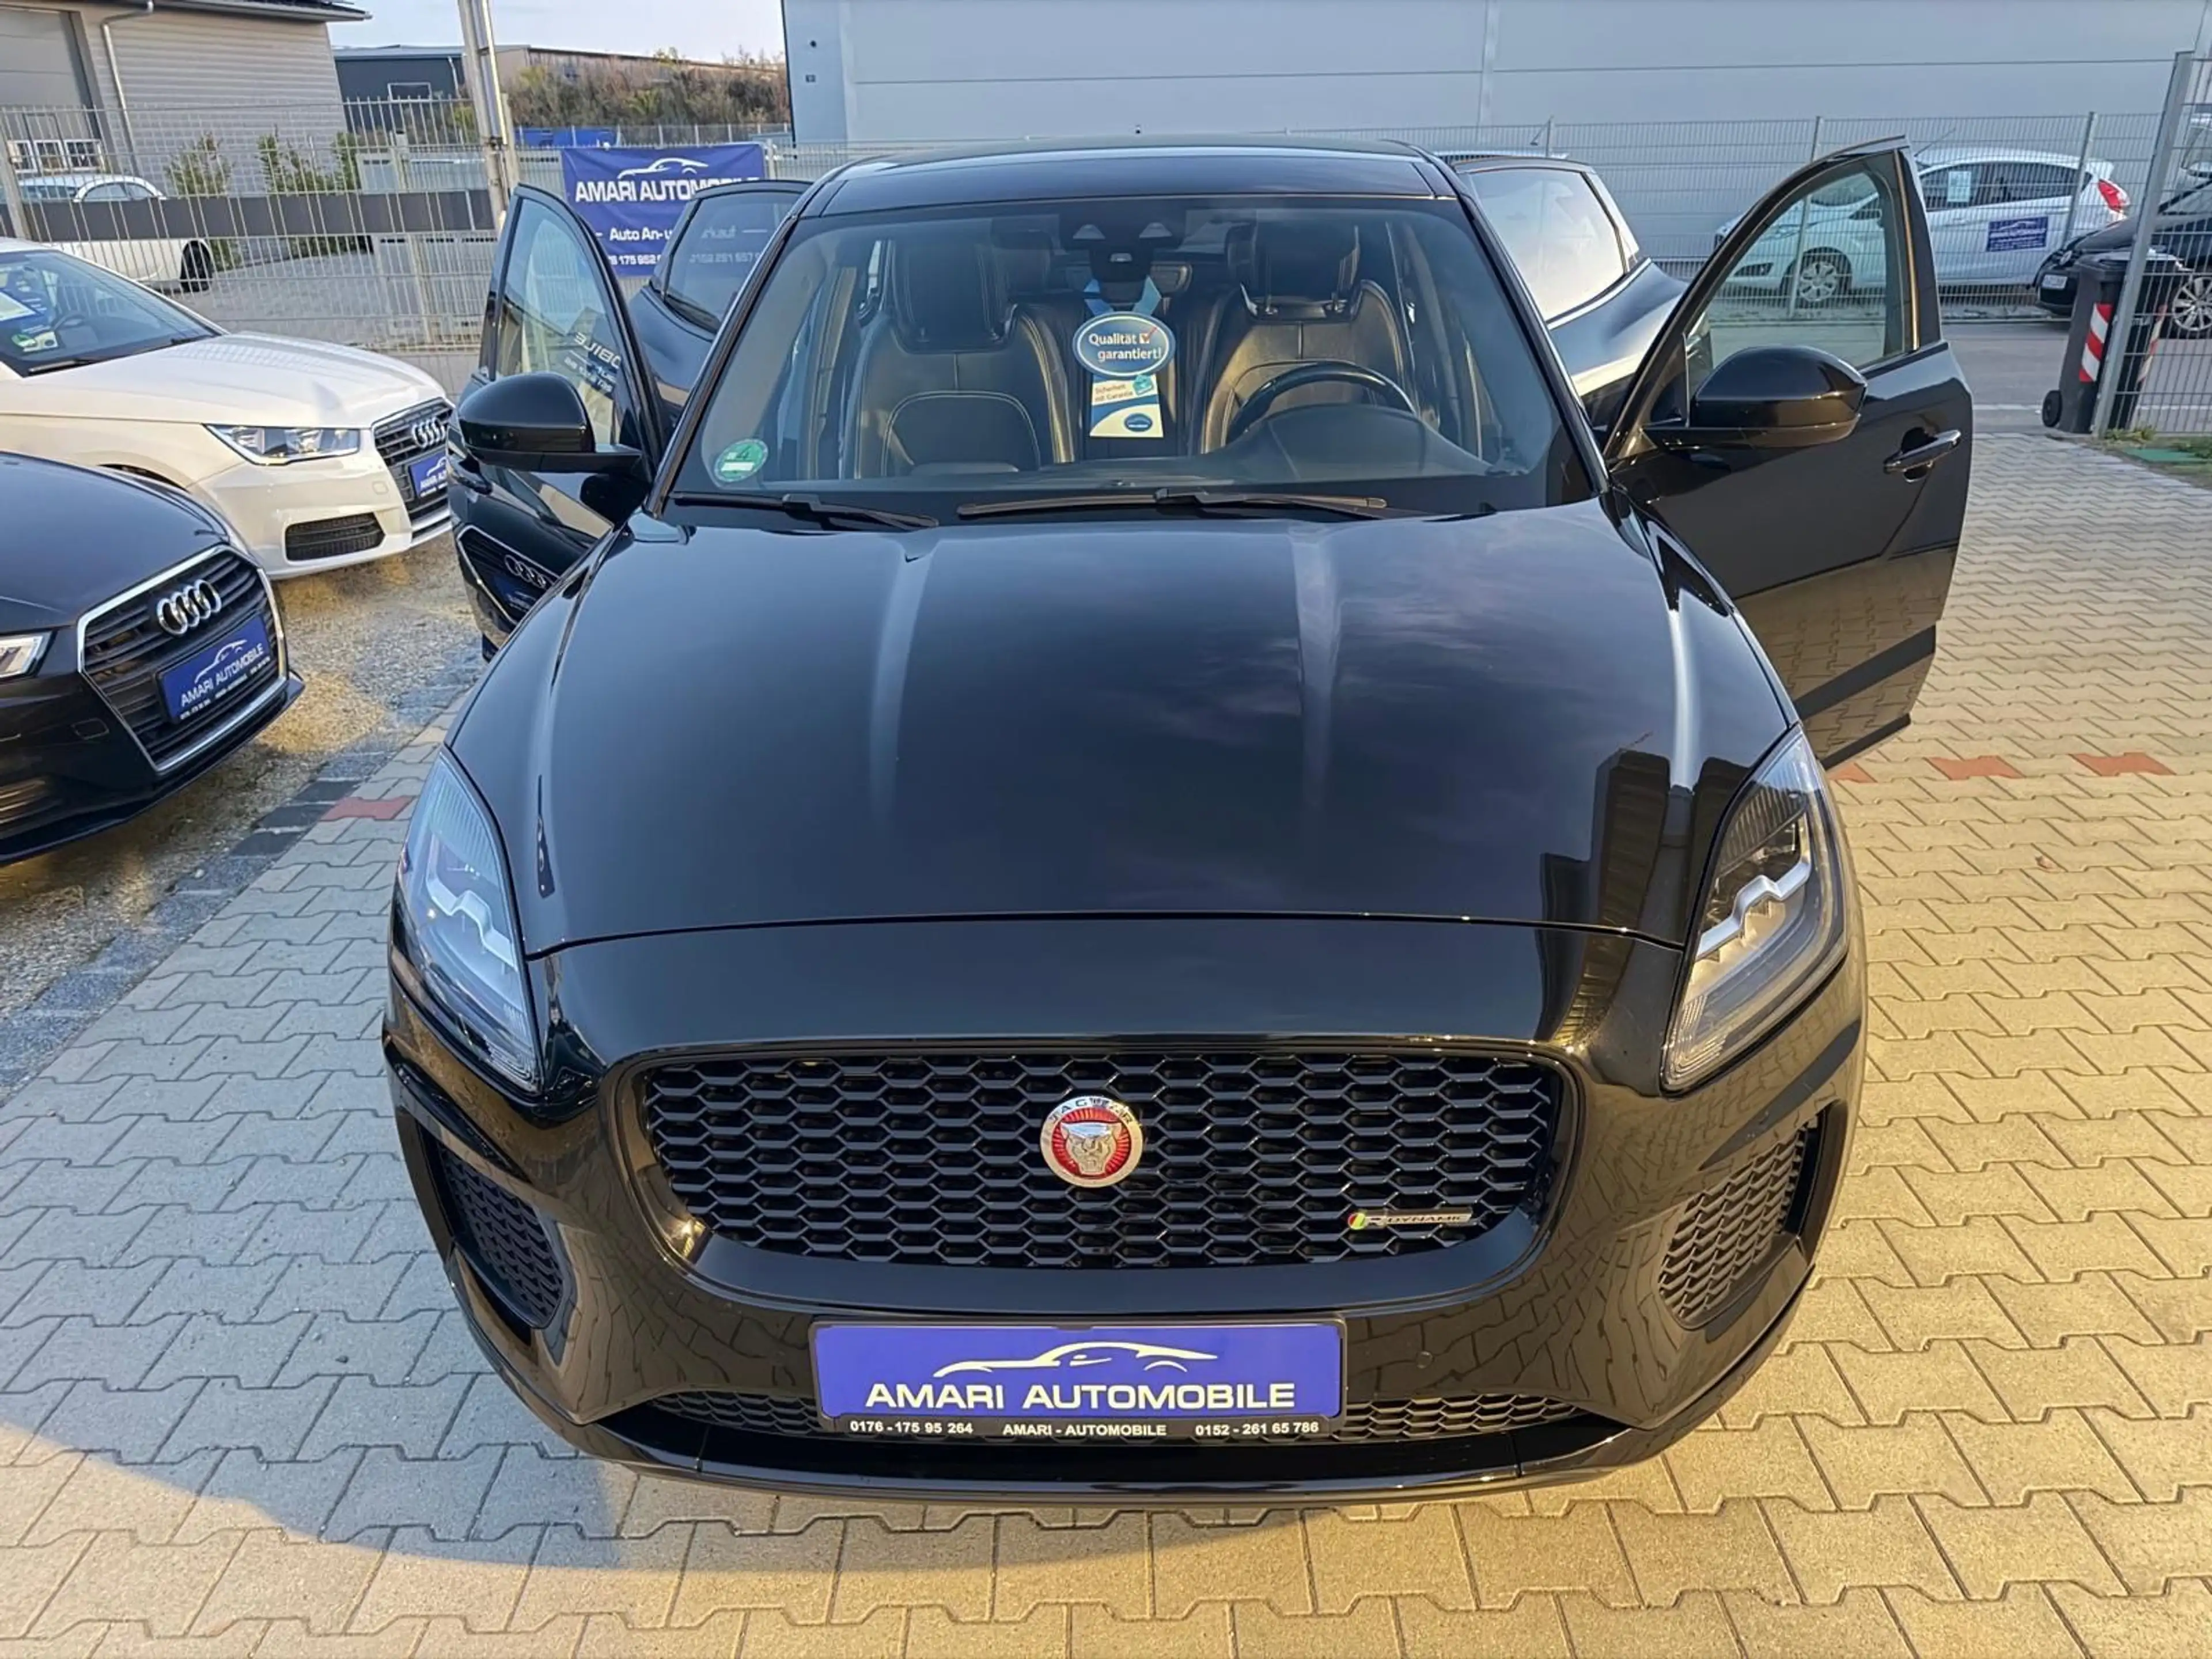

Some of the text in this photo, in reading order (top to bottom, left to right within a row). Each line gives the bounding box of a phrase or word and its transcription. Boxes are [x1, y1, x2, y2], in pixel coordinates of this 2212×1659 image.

[576, 181, 637, 202] AMARI
[609, 228, 639, 241] Auto
[1089, 332, 1137, 346] Qualität
[1097, 347, 1162, 362] garantiert!
[181, 677, 214, 707] AMARI
[215, 642, 264, 686] AUTOMOBILE
[865, 1383, 1295, 1410] AMARI AUTOMOBILE
[850, 1420, 883, 1433] 0176
[925, 1422, 942, 1434] 95
[948, 1422, 974, 1434] 264
[1002, 1423, 1052, 1436] AMARI
[1065, 1423, 1166, 1436] AUTOMOBILE
[1195, 1423, 1230, 1436] 0152
[1243, 1423, 1267, 1435] 261
[1272, 1422, 1290, 1434] 65
[1293, 1421, 1319, 1433] 786
